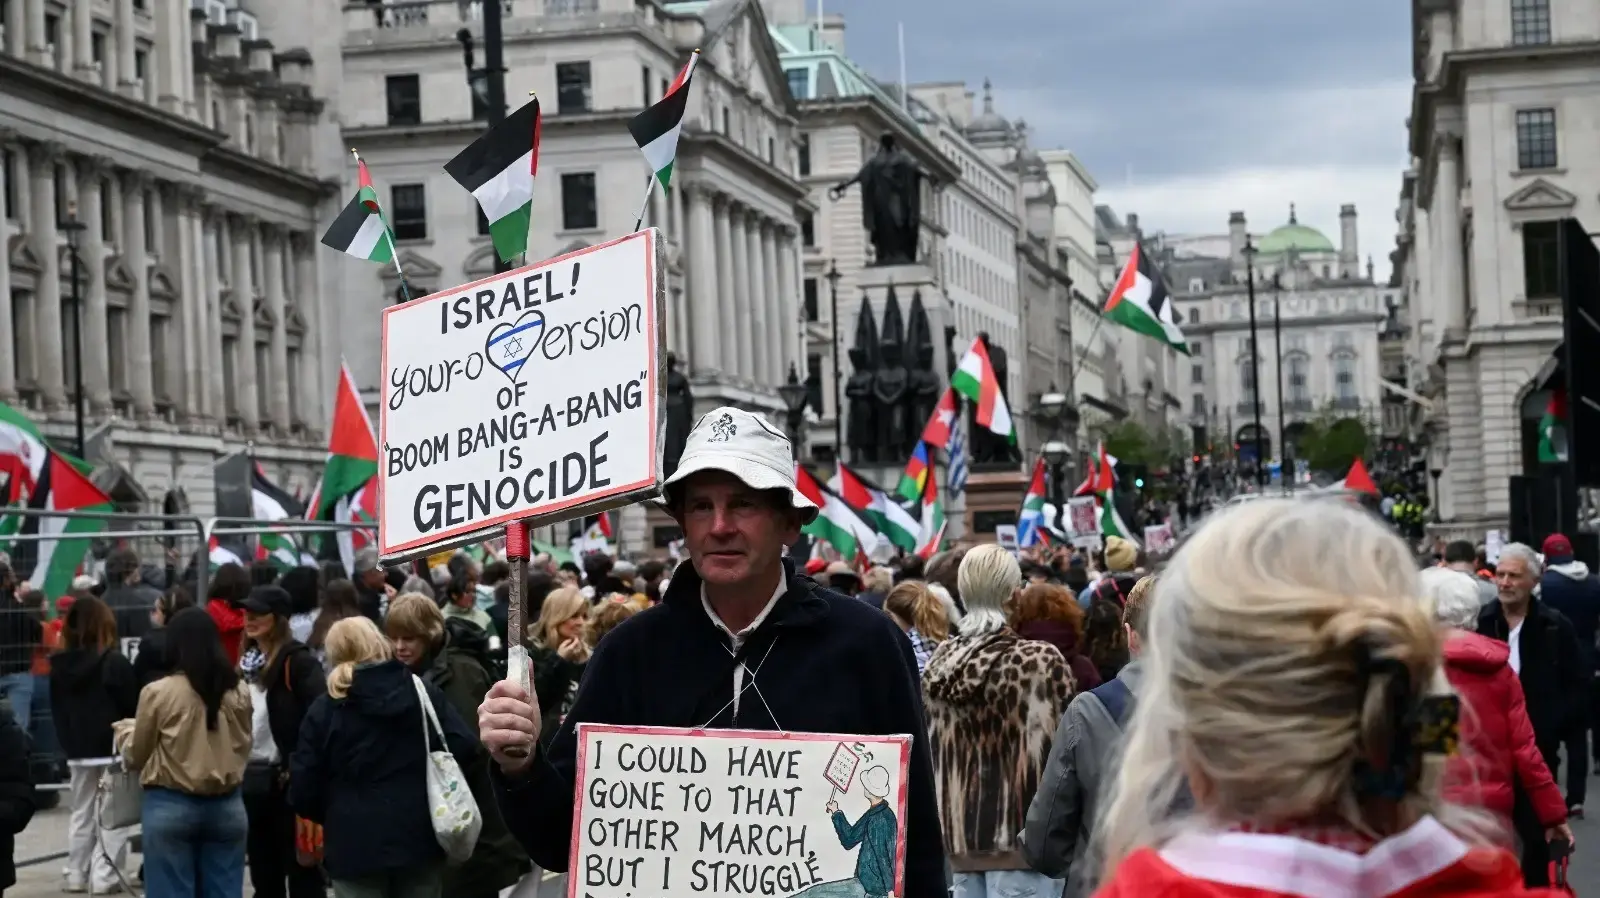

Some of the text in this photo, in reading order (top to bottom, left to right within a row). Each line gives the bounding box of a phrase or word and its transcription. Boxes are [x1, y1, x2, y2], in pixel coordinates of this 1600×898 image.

[441, 262, 581, 334] ISRAEL!
[496, 381, 528, 410] OF
[499, 445, 523, 472] IS
[413, 431, 611, 533] GENOCIDE
[594, 740, 603, 770] I
[617, 742, 707, 774] COULD
[727, 745, 802, 779] HAVE
[589, 777, 803, 816] GONE TO THAT
[588, 818, 816, 858] OTHER MARCH,
[585, 853, 823, 894] BUT I STRUGGLE
